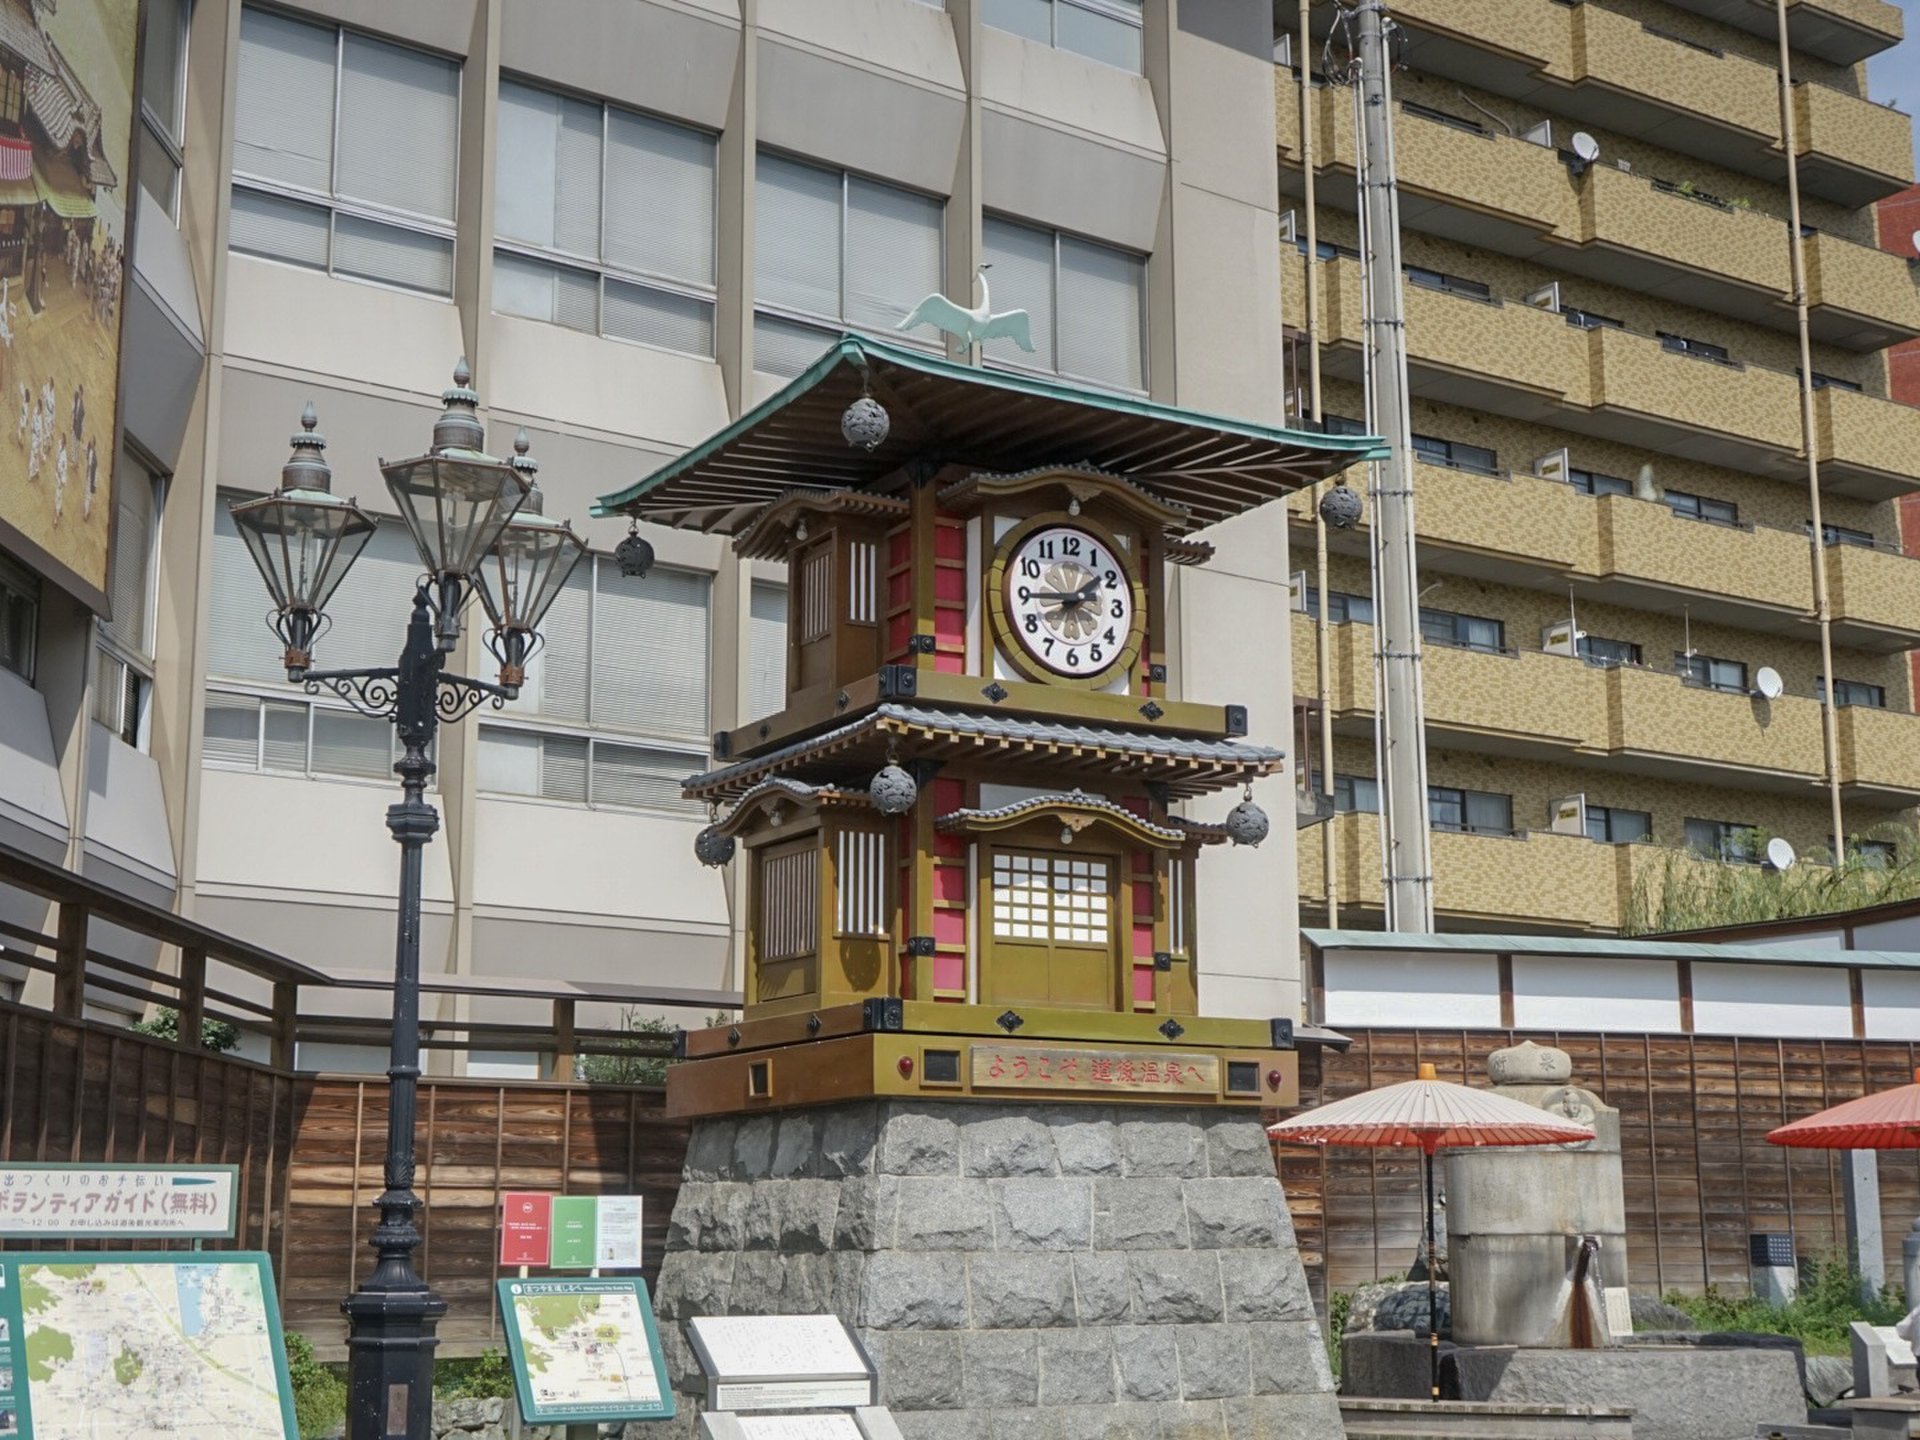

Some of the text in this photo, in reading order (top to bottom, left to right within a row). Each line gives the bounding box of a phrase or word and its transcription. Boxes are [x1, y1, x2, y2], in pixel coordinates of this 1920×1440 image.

[1039, 540, 1054, 559] 11
[1062, 536, 1080, 557] 12
[1090, 548, 1098, 567] 1
[1021, 557, 1041, 579] 10
[1105, 570, 1117, 590] 2
[1018, 586, 1031, 605] 9
[1111, 599, 1123, 619] 3
[1025, 613, 1038, 633] 8
[1103, 626, 1115, 645] 4
[1042, 638, 1055, 657] 7
[1090, 643, 1102, 662] 5
[1066, 648, 1079, 667] 6
[989, 1054, 1205, 1084] ようこそ 道後温泉へ
